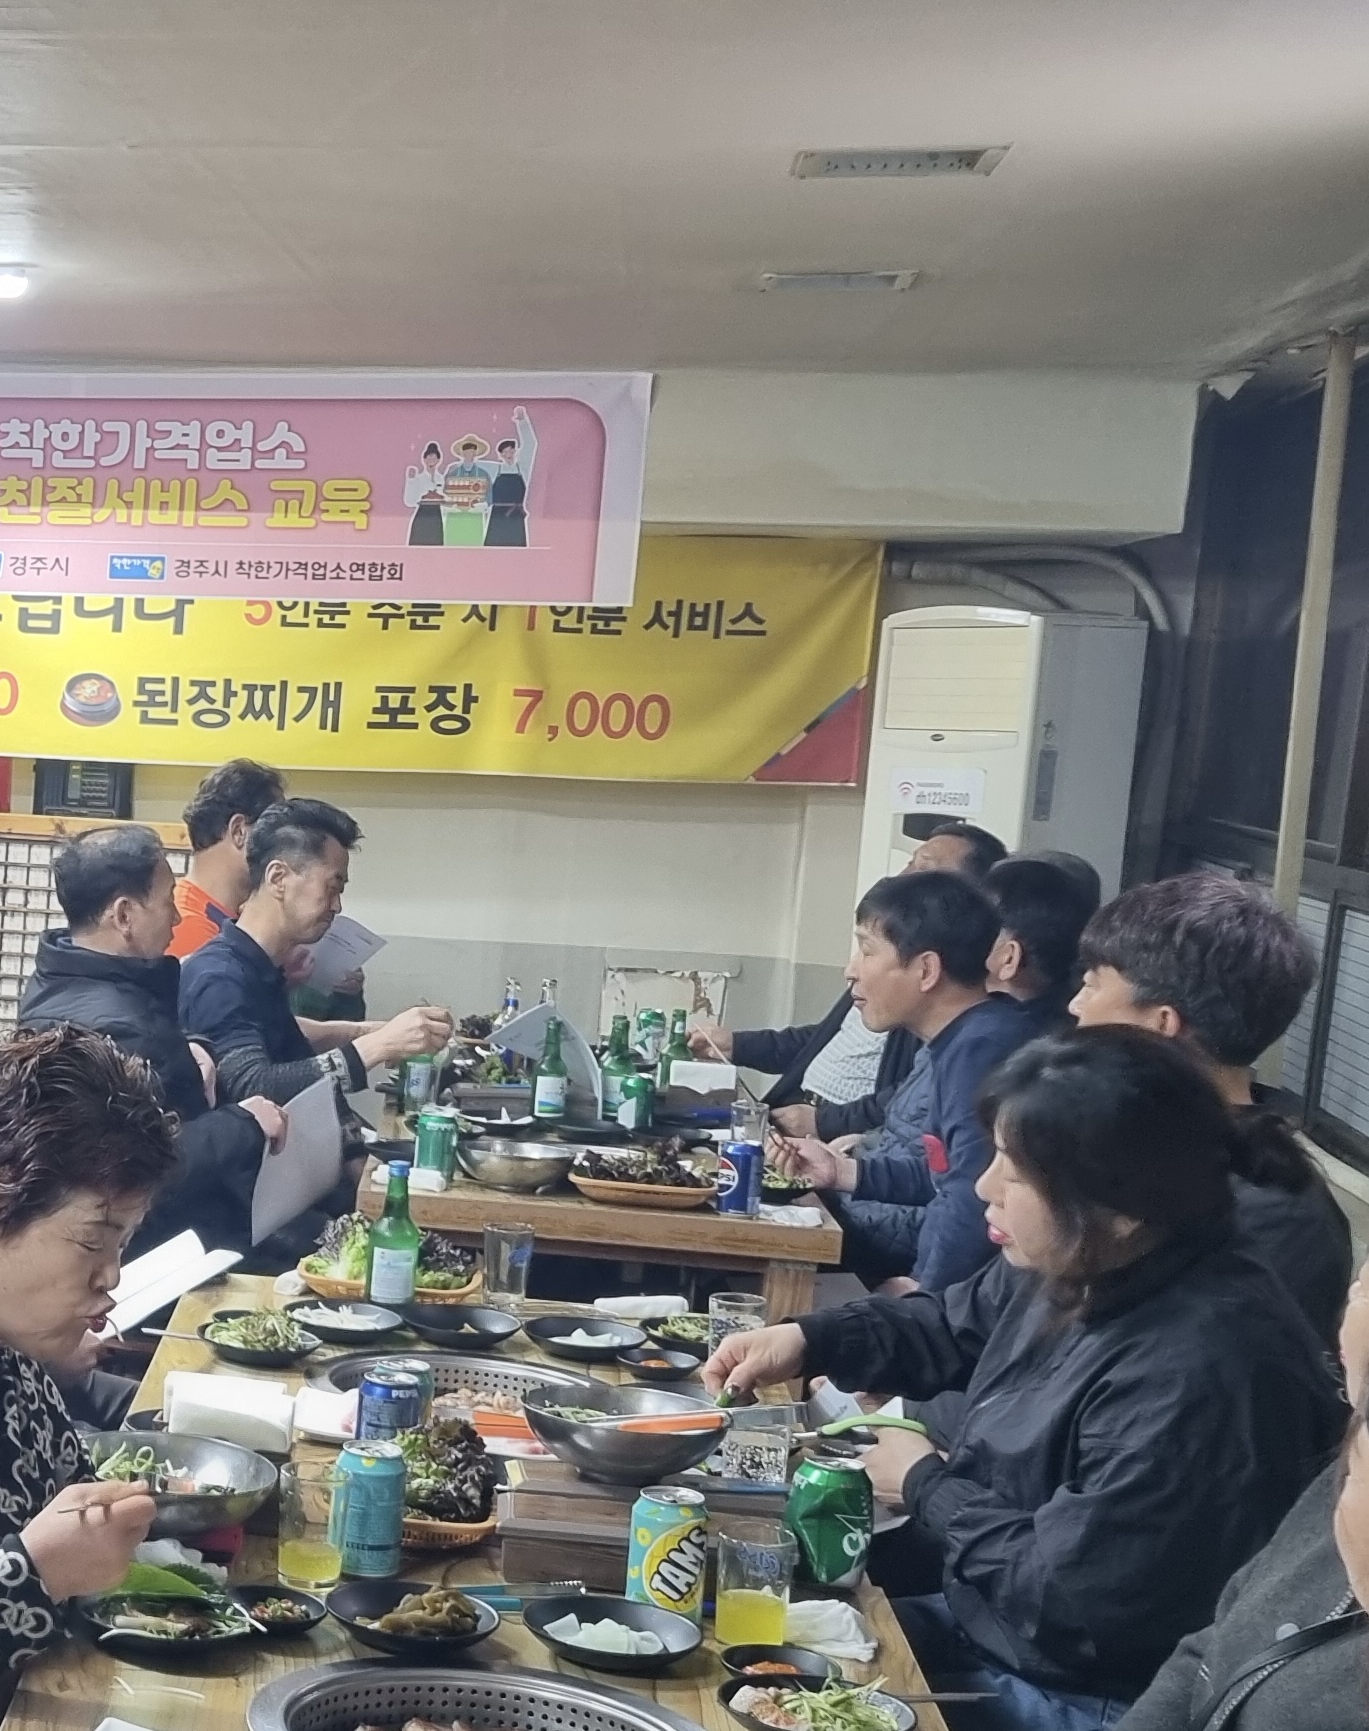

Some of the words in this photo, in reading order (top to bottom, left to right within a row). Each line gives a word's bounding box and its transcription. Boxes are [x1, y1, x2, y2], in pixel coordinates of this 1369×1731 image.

[265, 478, 372, 531] 교육
[9, 556, 70, 577] 경주시
[174, 559, 228, 579] 경주시
[235, 560, 405, 582] 착한가격업소연합회
[642, 599, 768, 639] 서비스
[132, 675, 343, 733] 된장찌개
[366, 683, 480, 736] 포장
[512, 688, 672, 743] 7,000
